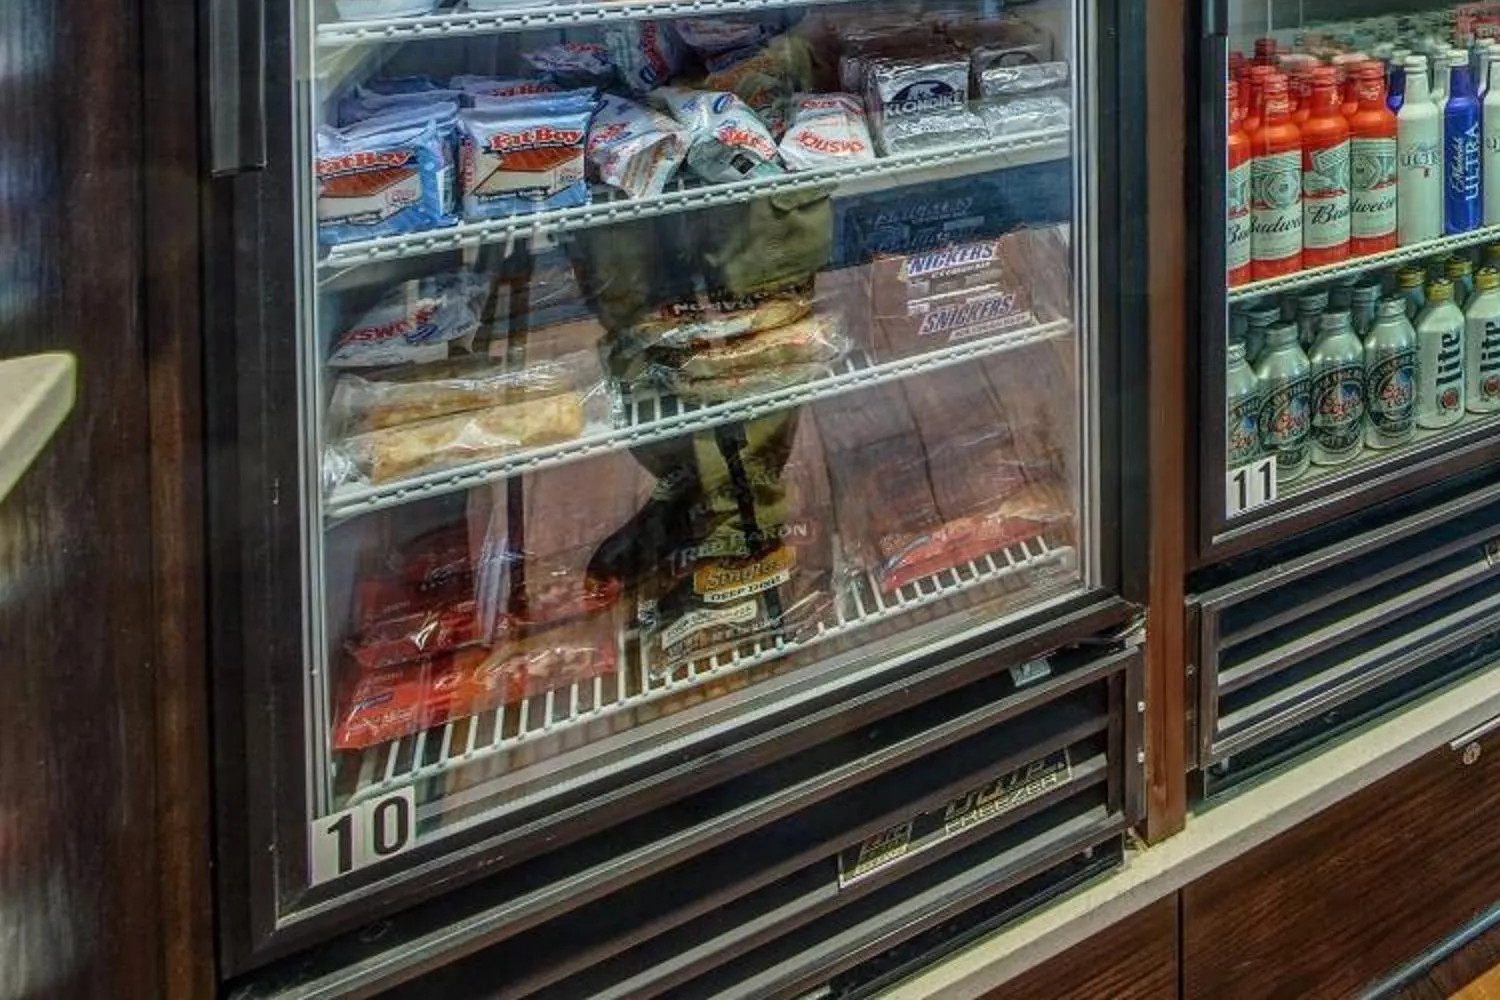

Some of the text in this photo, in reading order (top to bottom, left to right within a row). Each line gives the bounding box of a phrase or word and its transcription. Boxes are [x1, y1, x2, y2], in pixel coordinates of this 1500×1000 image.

[1465, 121, 1481, 201] ULTRA
[923, 294, 1015, 333] SNICKERS
[1436, 330, 1464, 389] lite
[1232, 461, 1274, 511] 11
[326, 795, 411, 875] 10
